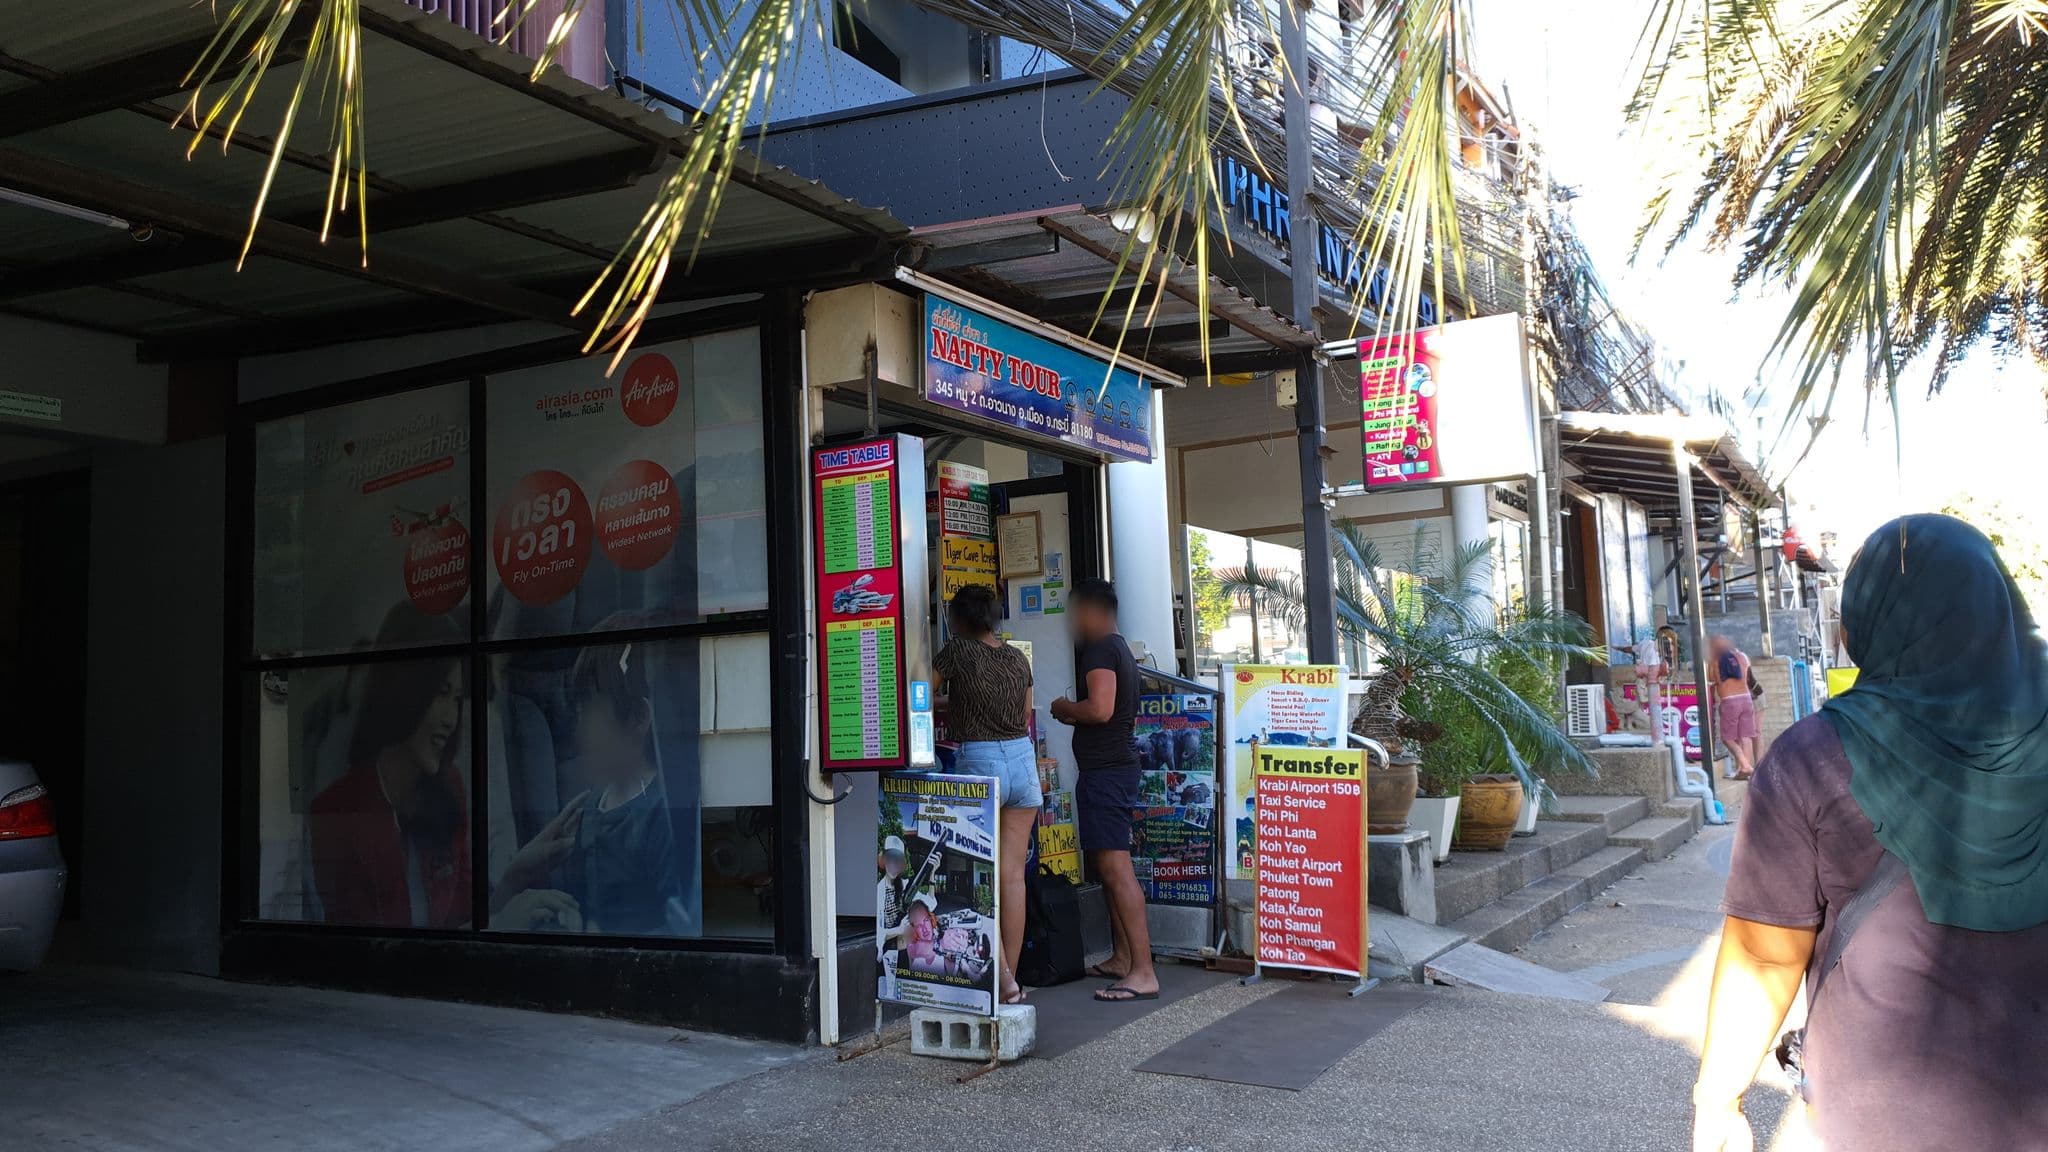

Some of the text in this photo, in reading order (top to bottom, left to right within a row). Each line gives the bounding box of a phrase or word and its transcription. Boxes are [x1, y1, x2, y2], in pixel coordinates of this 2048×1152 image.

[931, 326, 1061, 401] NATTY TOUR
[536, 386, 614, 411] airasia.com
[625, 374, 676, 408] AirAsia
[936, 379, 953, 398] 345
[956, 382, 968, 407] หมู่
[971, 390, 978, 405] 2
[1071, 421, 1093, 440] 81180
[820, 444, 889, 469] TIME TABLE
[600, 478, 669, 512] ครอบคลุม
[511, 487, 571, 530] ตรง
[502, 520, 576, 566] เวลา
[607, 525, 672, 551] Widest Network
[944, 540, 962, 564] Tiger
[513, 558, 577, 585] Fly On-Time
[1281, 668, 1334, 684] Krabi
[1136, 696, 1181, 715] rabi
[1261, 754, 1359, 775] Transfer
[884, 777, 989, 799] KRABI SHOOTING RANGE
[1260, 779, 1288, 791] Krabi
[1290, 780, 1330, 795] Airport
[1259, 794, 1327, 809] Taxi Service
[1260, 809, 1299, 823] Phi Phi
[1260, 824, 1317, 840] Koh Lanta
[1260, 839, 1307, 854] Koh Yao
[1154, 866, 1180, 877] BOOK
[1182, 865, 1207, 876] HERE
[1260, 855, 1299, 868] Phuket
[1302, 858, 1342, 873] Airport
[1260, 870, 1333, 887] Phuket Town
[1260, 885, 1300, 903] Patong
[1260, 900, 1323, 918] Kata,Karon
[1260, 916, 1321, 933] Koh Samui
[1260, 931, 1336, 951] Koh Phangan
[1260, 946, 1305, 961] Koh Tao
